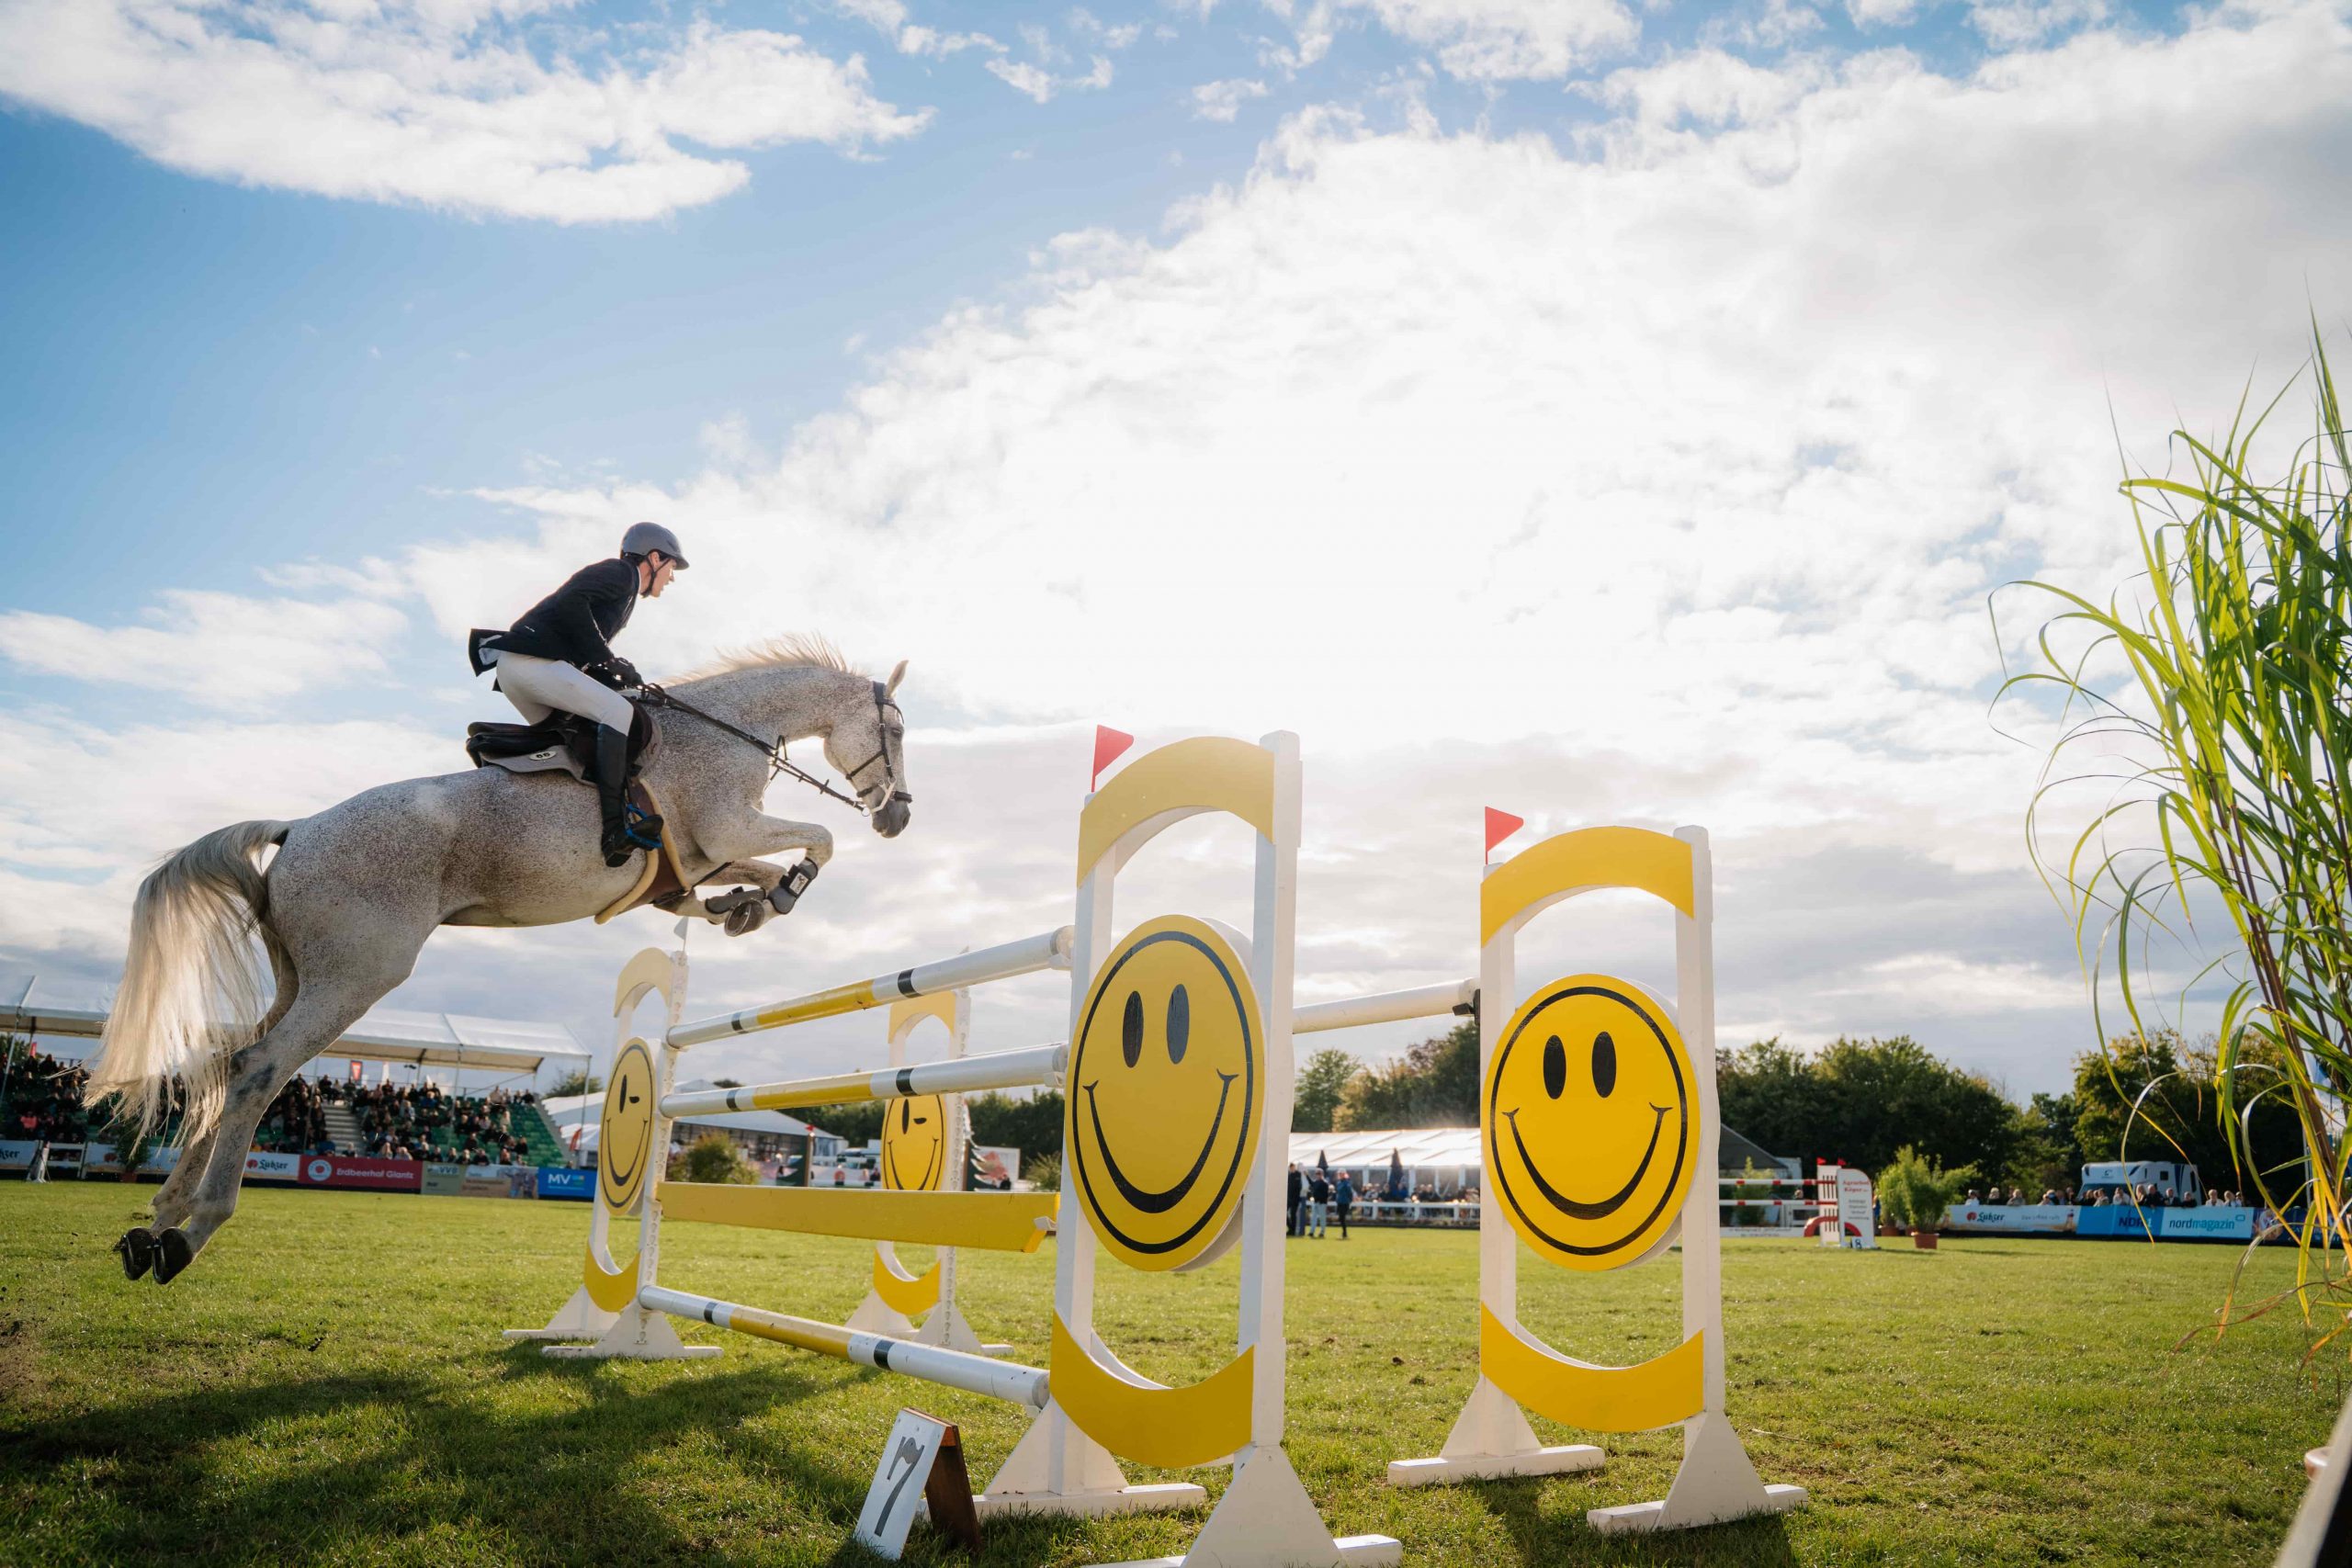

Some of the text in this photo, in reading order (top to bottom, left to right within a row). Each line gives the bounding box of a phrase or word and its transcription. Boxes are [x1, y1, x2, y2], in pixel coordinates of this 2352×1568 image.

[548, 1174, 571, 1184] MV
[2169, 1218, 2235, 1232] nordmagazin
[874, 1436, 925, 1538] 7
